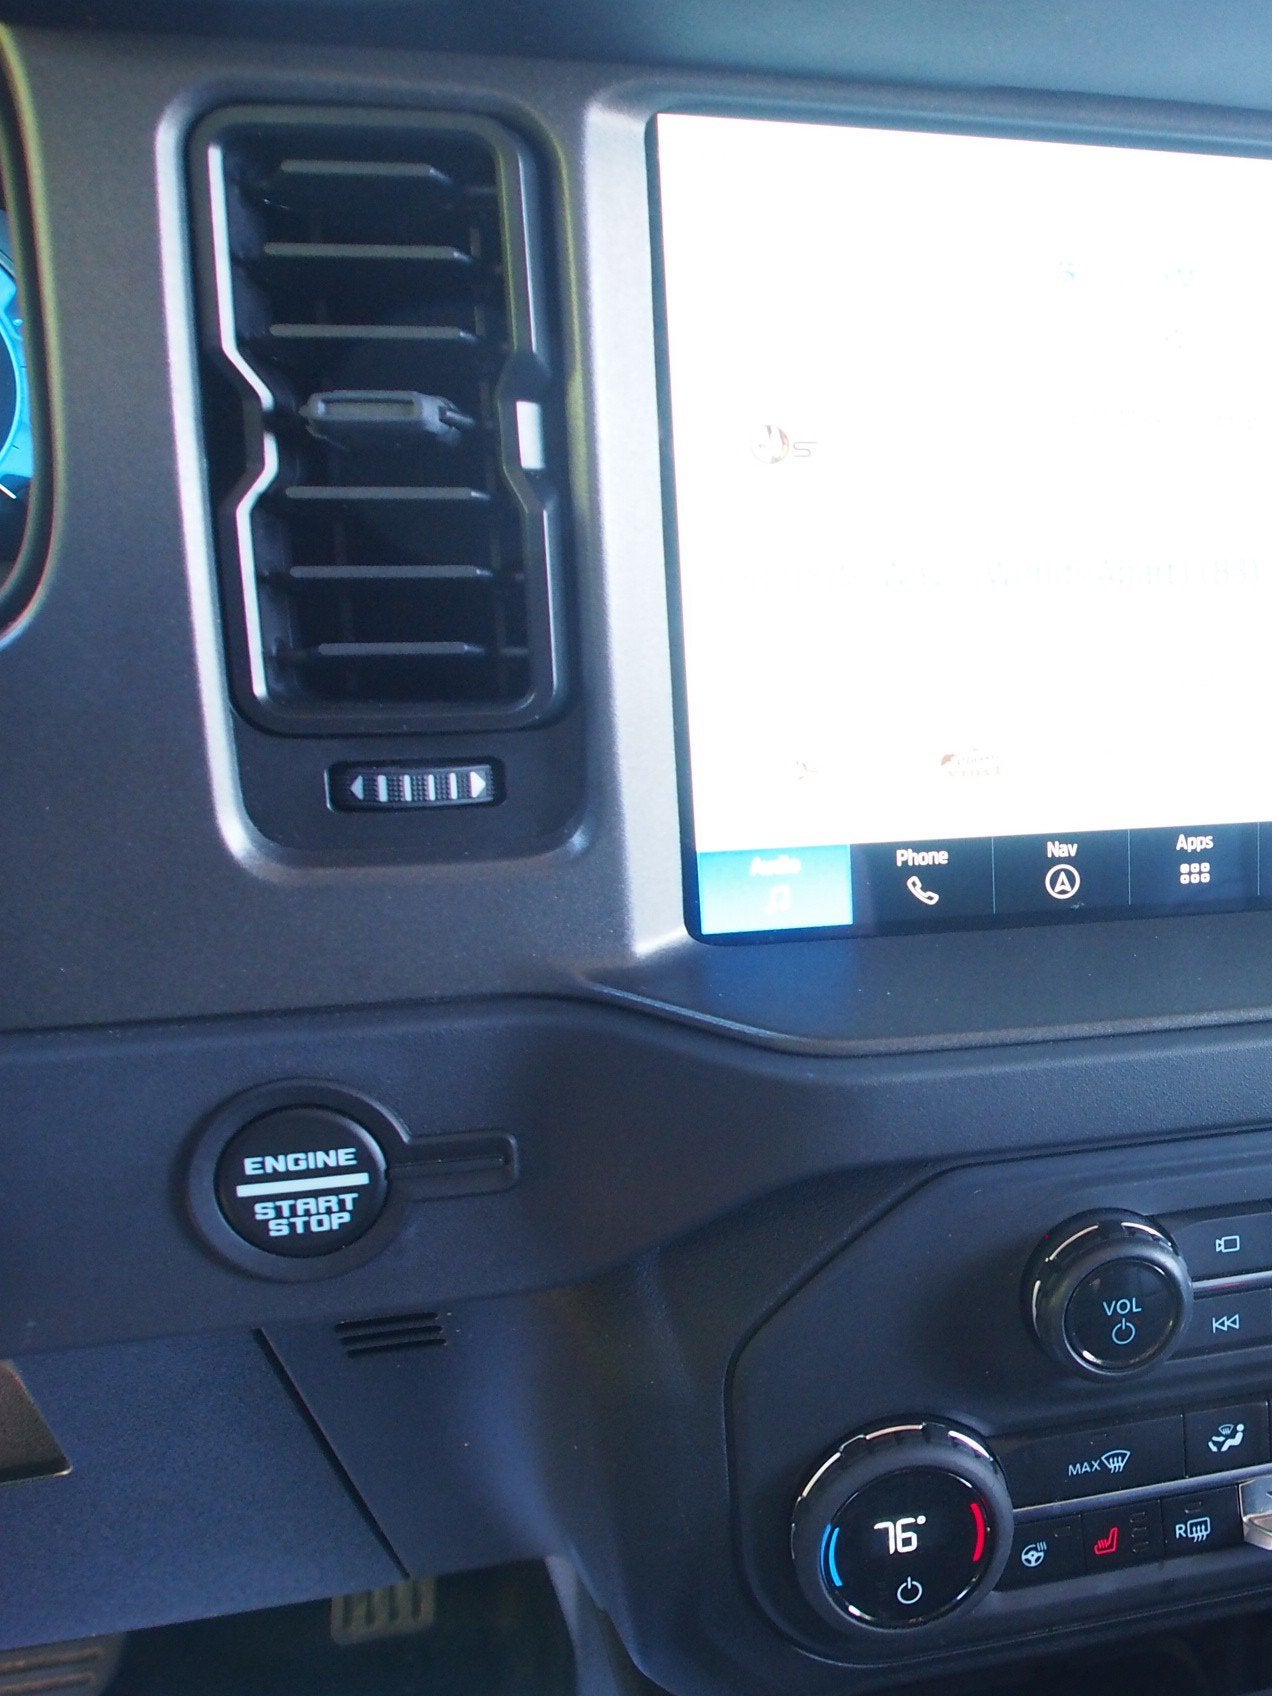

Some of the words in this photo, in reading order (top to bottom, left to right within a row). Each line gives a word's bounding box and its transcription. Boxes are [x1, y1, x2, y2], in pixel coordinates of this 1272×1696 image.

[1046, 840, 1078, 858] Nav
[1175, 833, 1214, 853] Apps
[896, 848, 949, 867] Phone
[243, 1147, 358, 1176] ENGINE
[253, 1193, 359, 1220] START
[267, 1212, 352, 1237] STOP
[1102, 1297, 1142, 1316] VOL
[1068, 1459, 1101, 1476] MAX
[873, 1514, 928, 1556] 76°
[1175, 1524, 1187, 1539] R
